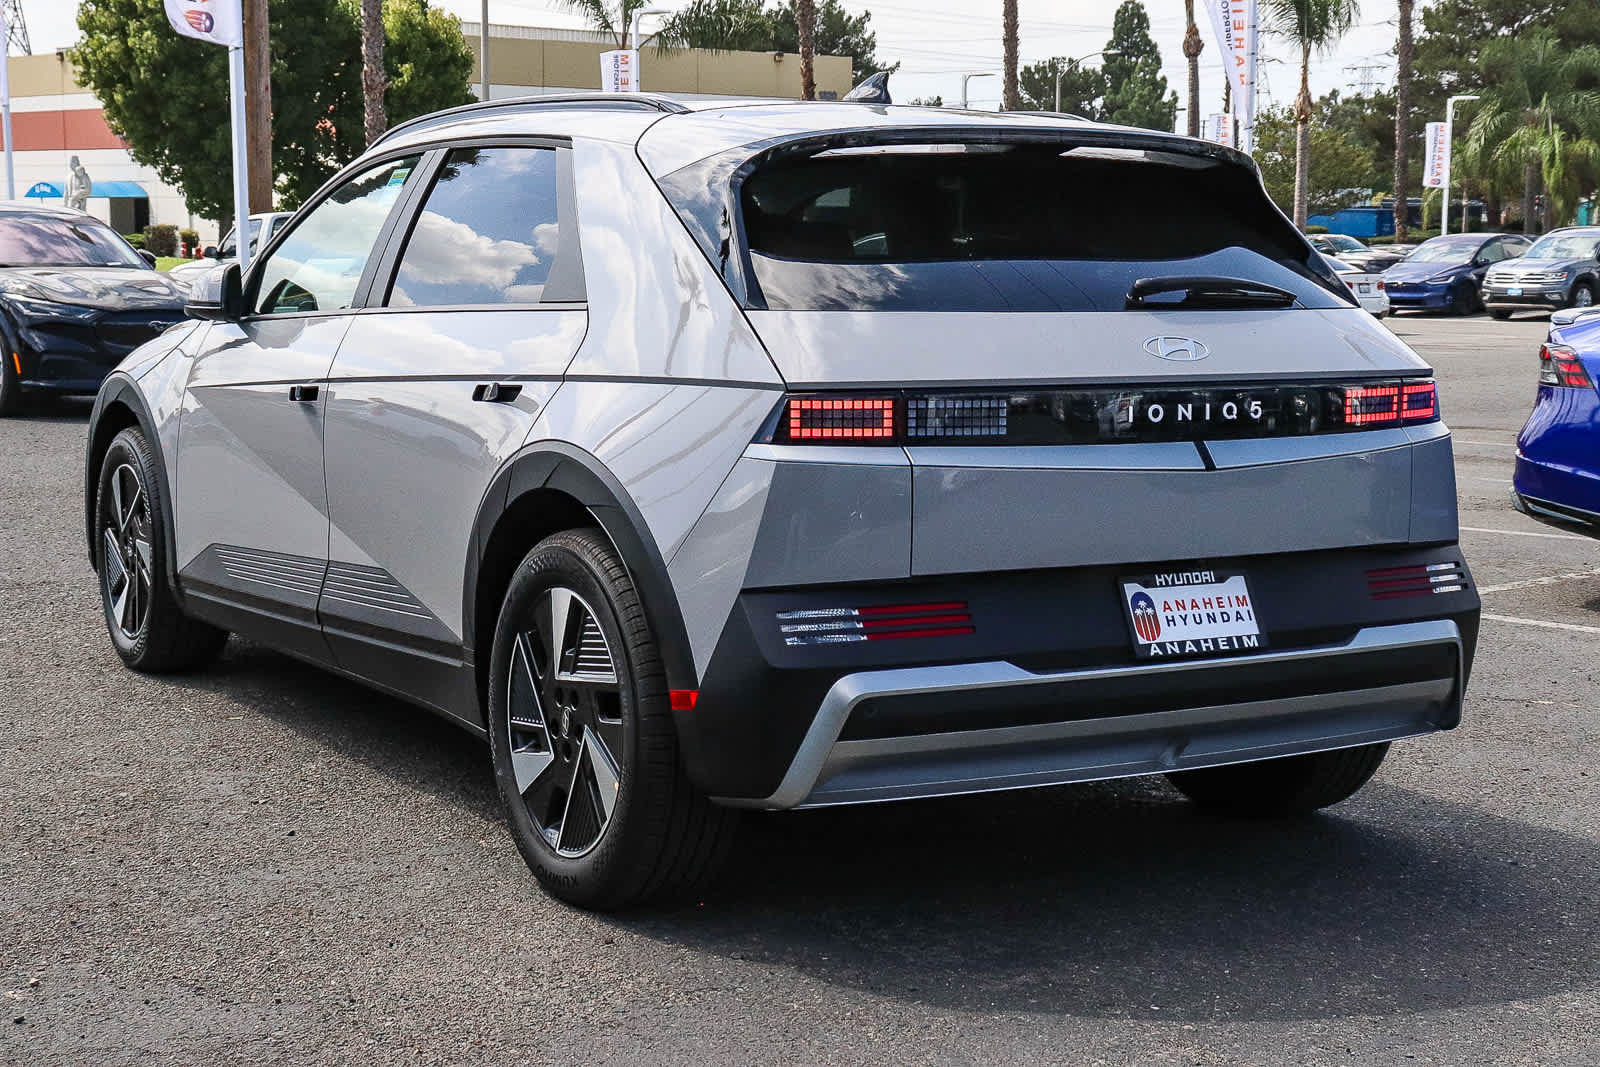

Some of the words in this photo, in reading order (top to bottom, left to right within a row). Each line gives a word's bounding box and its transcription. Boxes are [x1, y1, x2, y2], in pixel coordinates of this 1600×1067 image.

[1155, 570, 1216, 586] HYUNDAI
[1162, 595, 1249, 612] ANAHEIM
[1165, 609, 1253, 627] HYUNDAI
[1150, 635, 1260, 657] ANAHEIM
